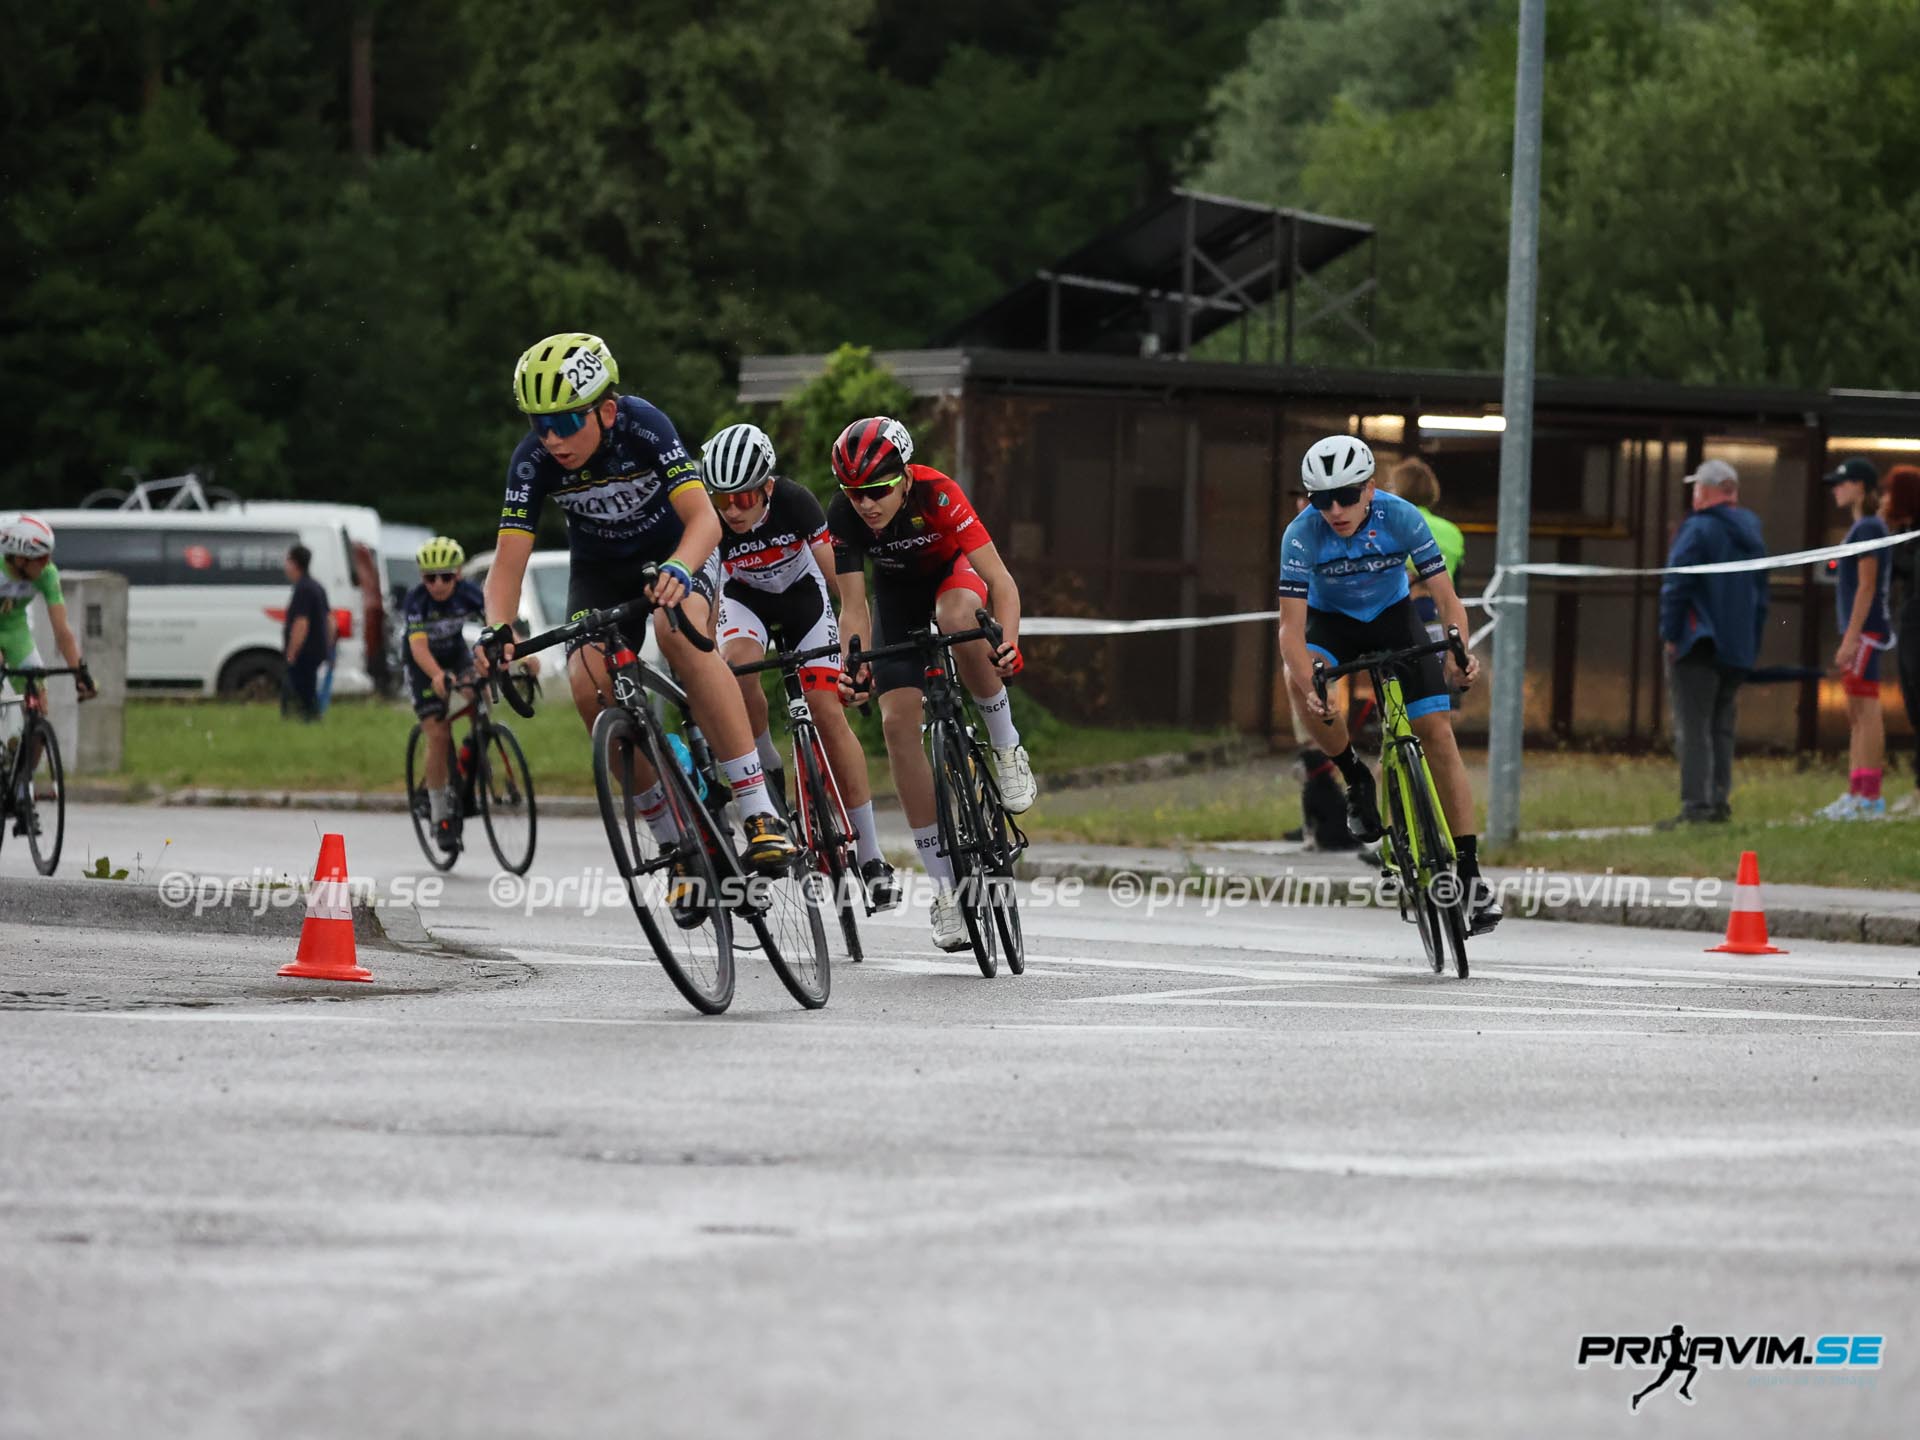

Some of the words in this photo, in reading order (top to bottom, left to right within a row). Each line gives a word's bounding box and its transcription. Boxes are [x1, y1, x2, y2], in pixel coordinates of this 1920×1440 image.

[567, 351, 602, 391] 239
[659, 446, 686, 465] tus
[505, 487, 529, 503] tus
[728, 539, 767, 560] SLOGA
